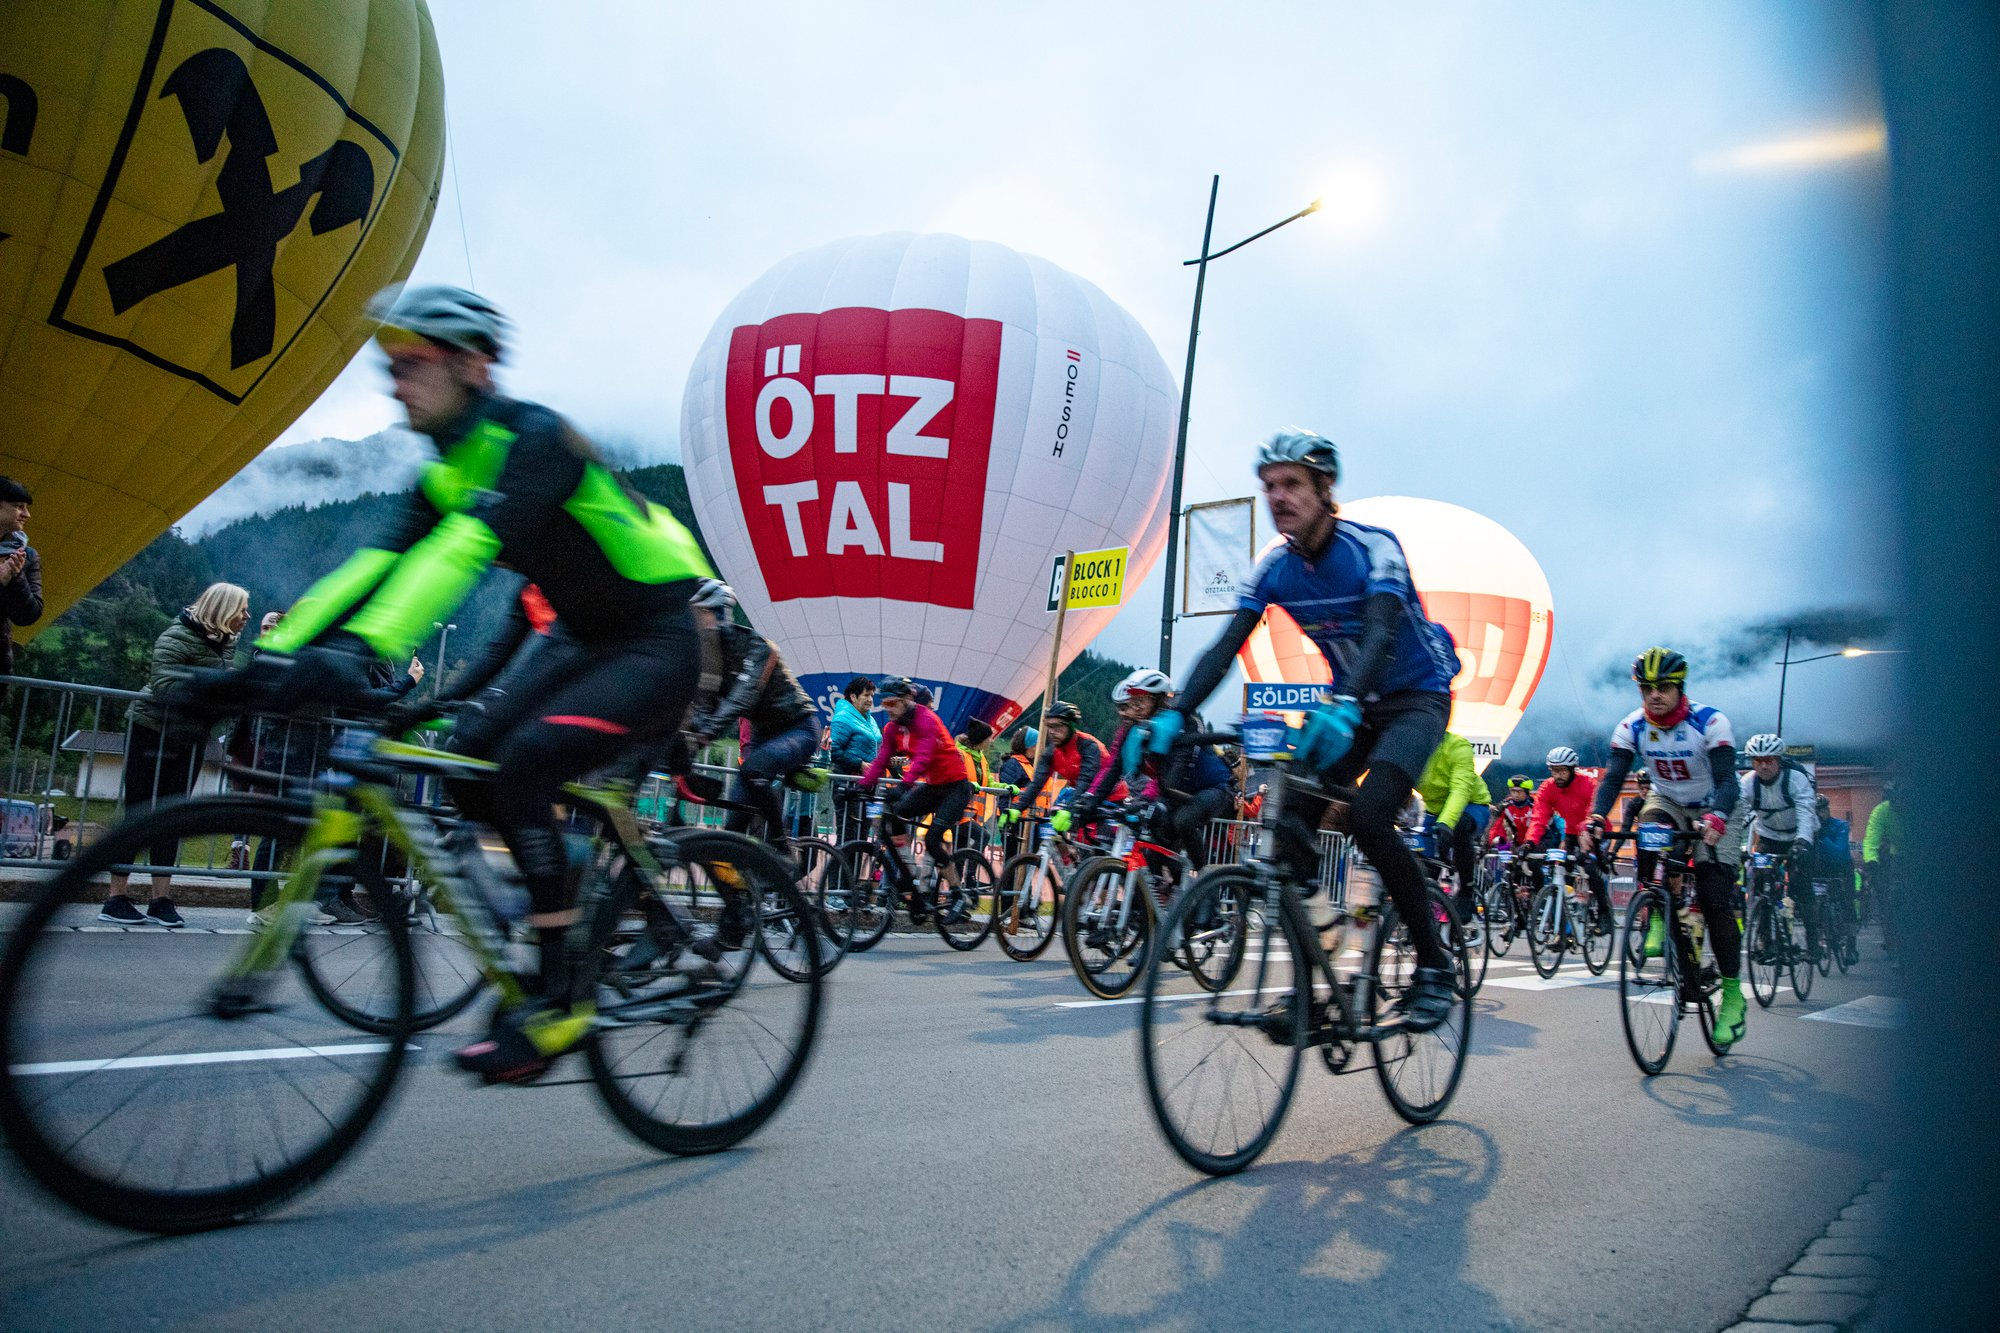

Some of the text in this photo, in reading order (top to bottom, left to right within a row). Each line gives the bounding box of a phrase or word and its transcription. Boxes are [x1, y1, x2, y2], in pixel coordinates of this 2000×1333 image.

[755, 344, 955, 459] ÖTZ
[763, 480, 945, 563] TAL
[1073, 558, 1121, 581] BLOCK 1
[1070, 583, 1117, 600] BLOCCO 1
[1252, 686, 1325, 707] SÖLDEN
